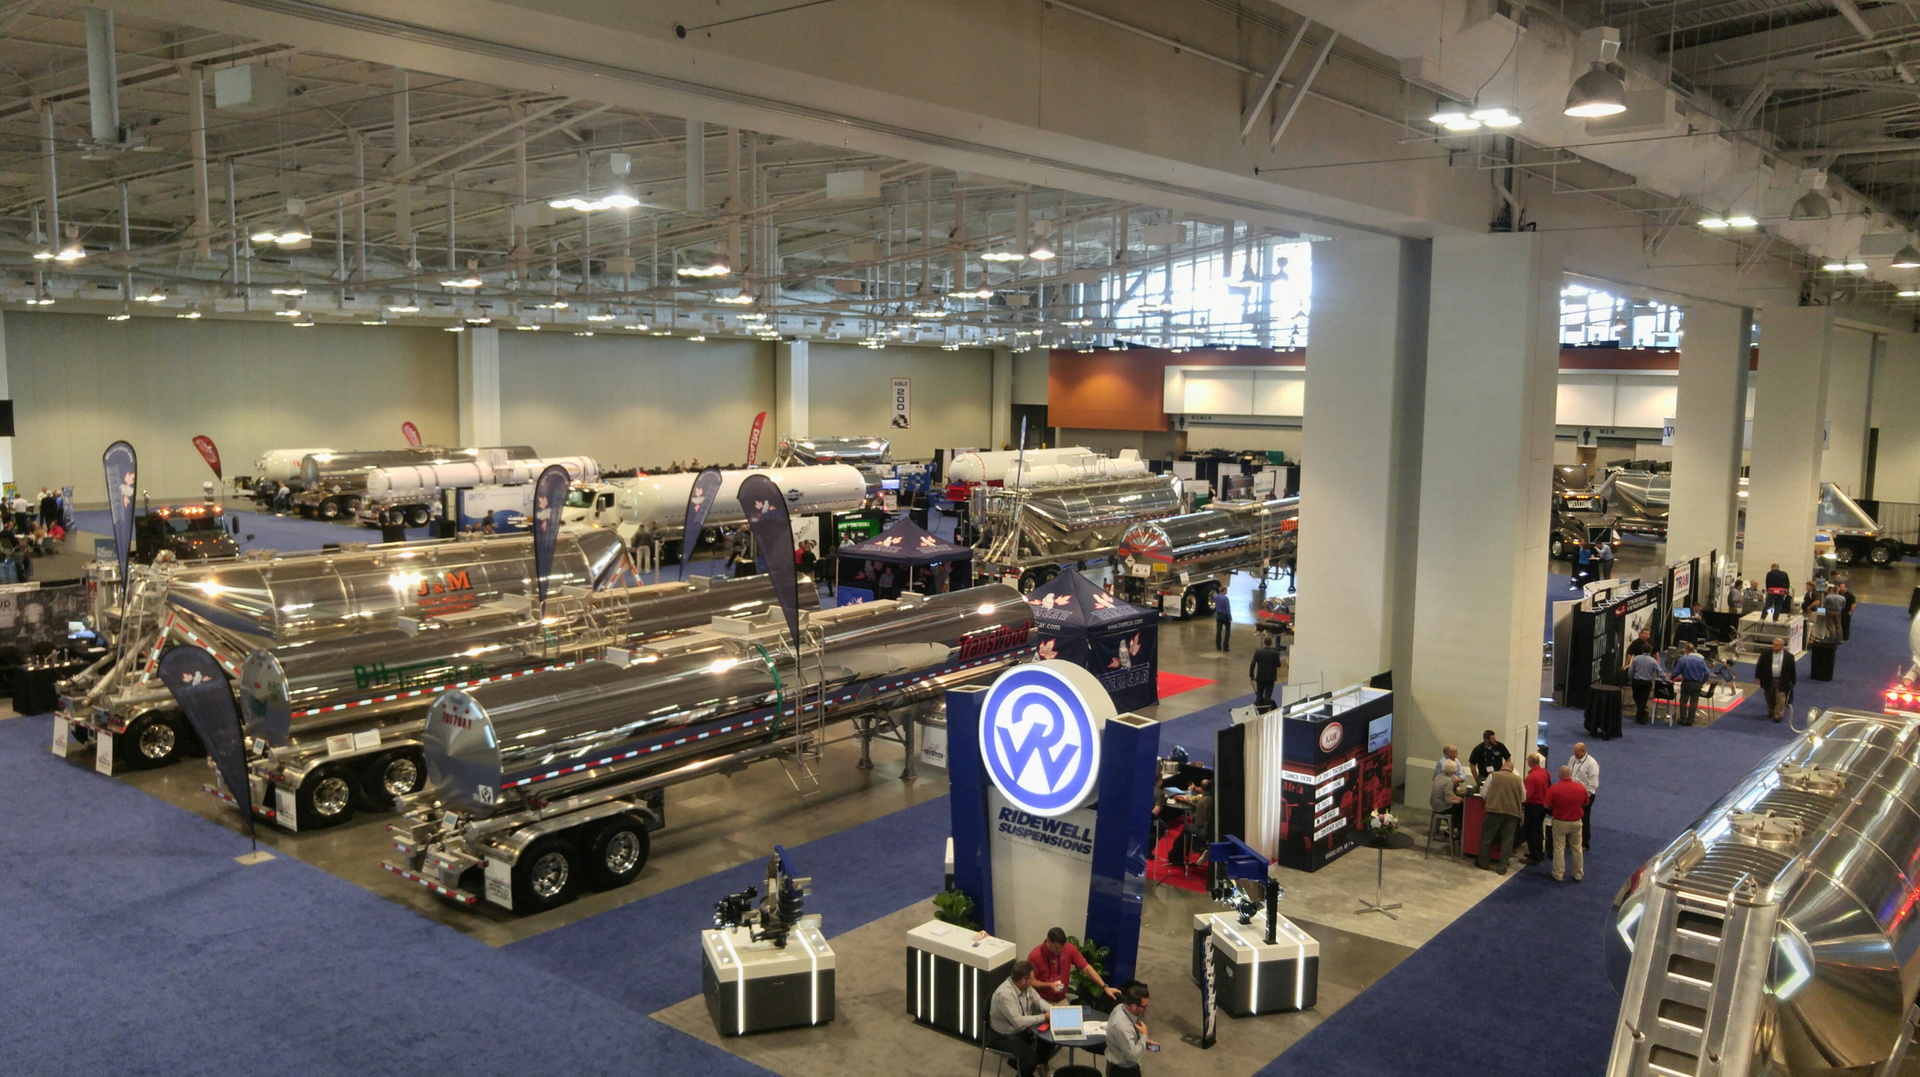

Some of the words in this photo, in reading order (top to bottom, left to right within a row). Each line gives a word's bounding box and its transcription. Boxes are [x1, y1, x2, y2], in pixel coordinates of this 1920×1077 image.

[896, 388, 905, 411] 200
[1567, 500, 1594, 509] WELCOME
[417, 579, 429, 597] J
[434, 581, 446, 595] &
[446, 571, 473, 592] M
[958, 620, 1031, 662] TransWood
[1100, 669, 1150, 693] REMCAR
[1285, 772, 1299, 780] SINCE
[1300, 774, 1312, 783] 1930
[998, 807, 1092, 843] RIDEWELL
[998, 822, 1093, 855] SUSPENSIONS
